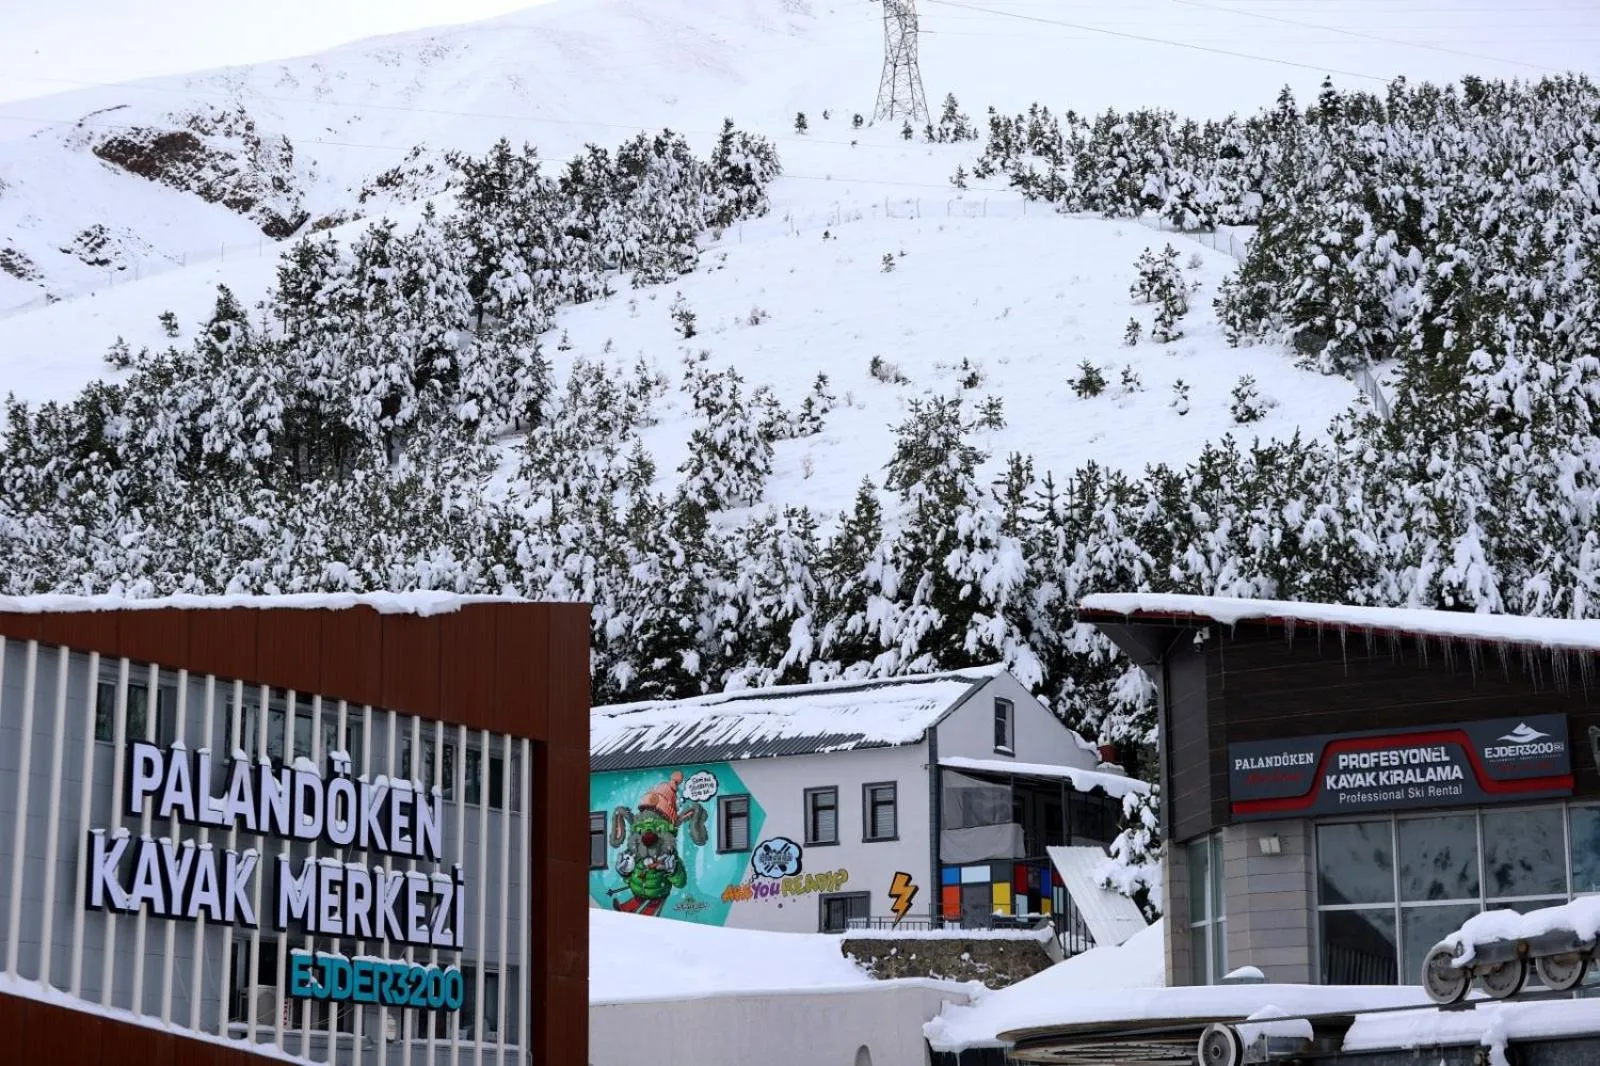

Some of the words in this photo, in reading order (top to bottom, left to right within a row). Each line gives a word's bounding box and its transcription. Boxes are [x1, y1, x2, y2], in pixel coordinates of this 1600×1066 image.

[1234, 752, 1314, 770] PALANDÖKEN
[1338, 746, 1451, 770] PROFESYONEL
[1484, 743, 1554, 759] EJDER3200
[1326, 772, 1377, 790] KAYAK
[127, 741, 442, 860] PALANDÖKEN
[1339, 788, 1404, 804] Professional
[1408, 786, 1424, 799] Ski
[1428, 784, 1462, 796] Rental
[88, 829, 259, 926] KAYAK
[276, 857, 464, 949] MERKEZİ
[752, 882, 779, 899] YOU
[781, 868, 848, 896] READY?
[289, 951, 464, 1011] EJDER3200
